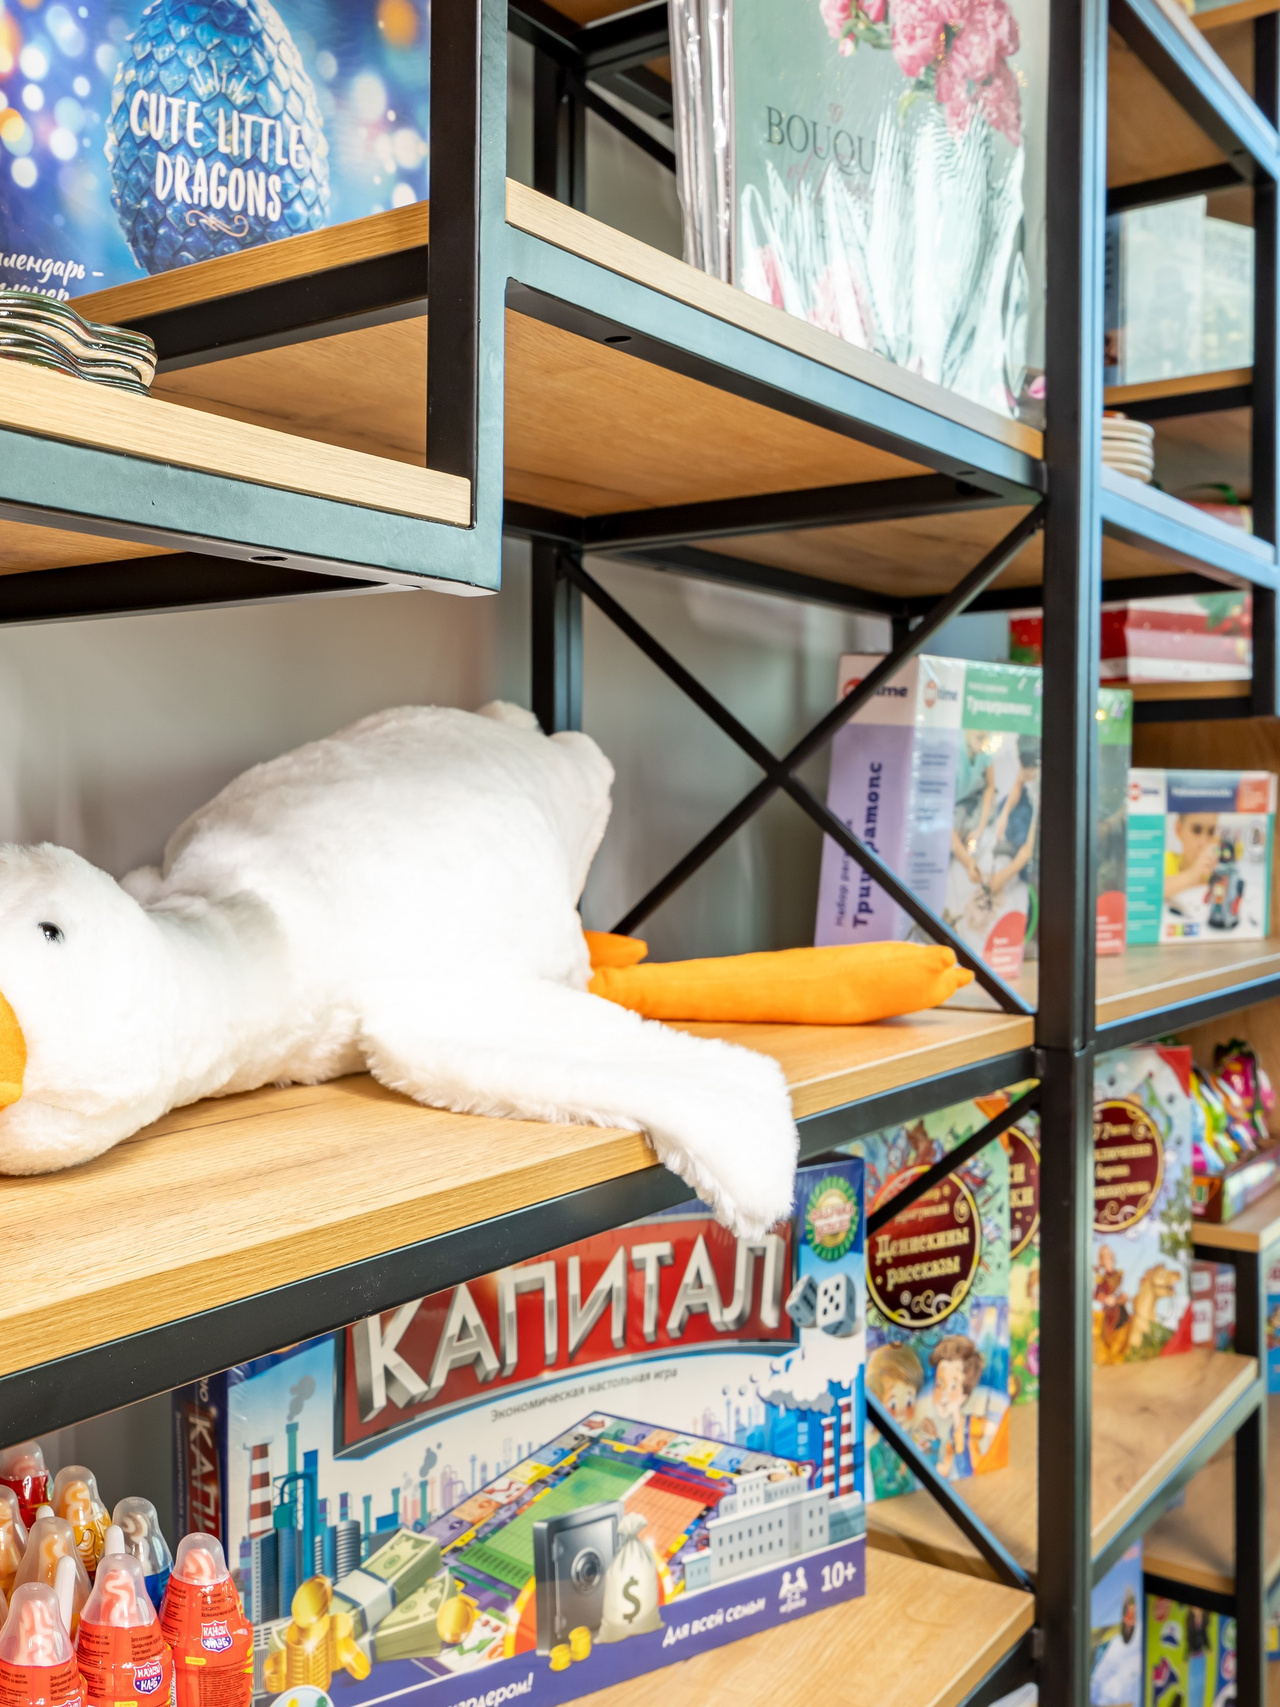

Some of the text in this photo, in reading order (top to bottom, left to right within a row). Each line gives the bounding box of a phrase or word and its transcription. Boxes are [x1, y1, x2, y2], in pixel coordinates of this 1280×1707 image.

[130, 89, 306, 170] CUTE LITTLE
[766, 106, 878, 176] BOUQU
[155, 151, 283, 222] DRAGONS
[875, 1226, 970, 1266] Денискины
[886, 1256, 961, 1292] рассказы
[352, 1233, 787, 1424] КАПИТАЛ
[490, 1366, 678, 1423] Экономическая настольная игра
[821, 1561, 857, 1593] 10+
[662, 1596, 767, 1649] Для всей семьи
